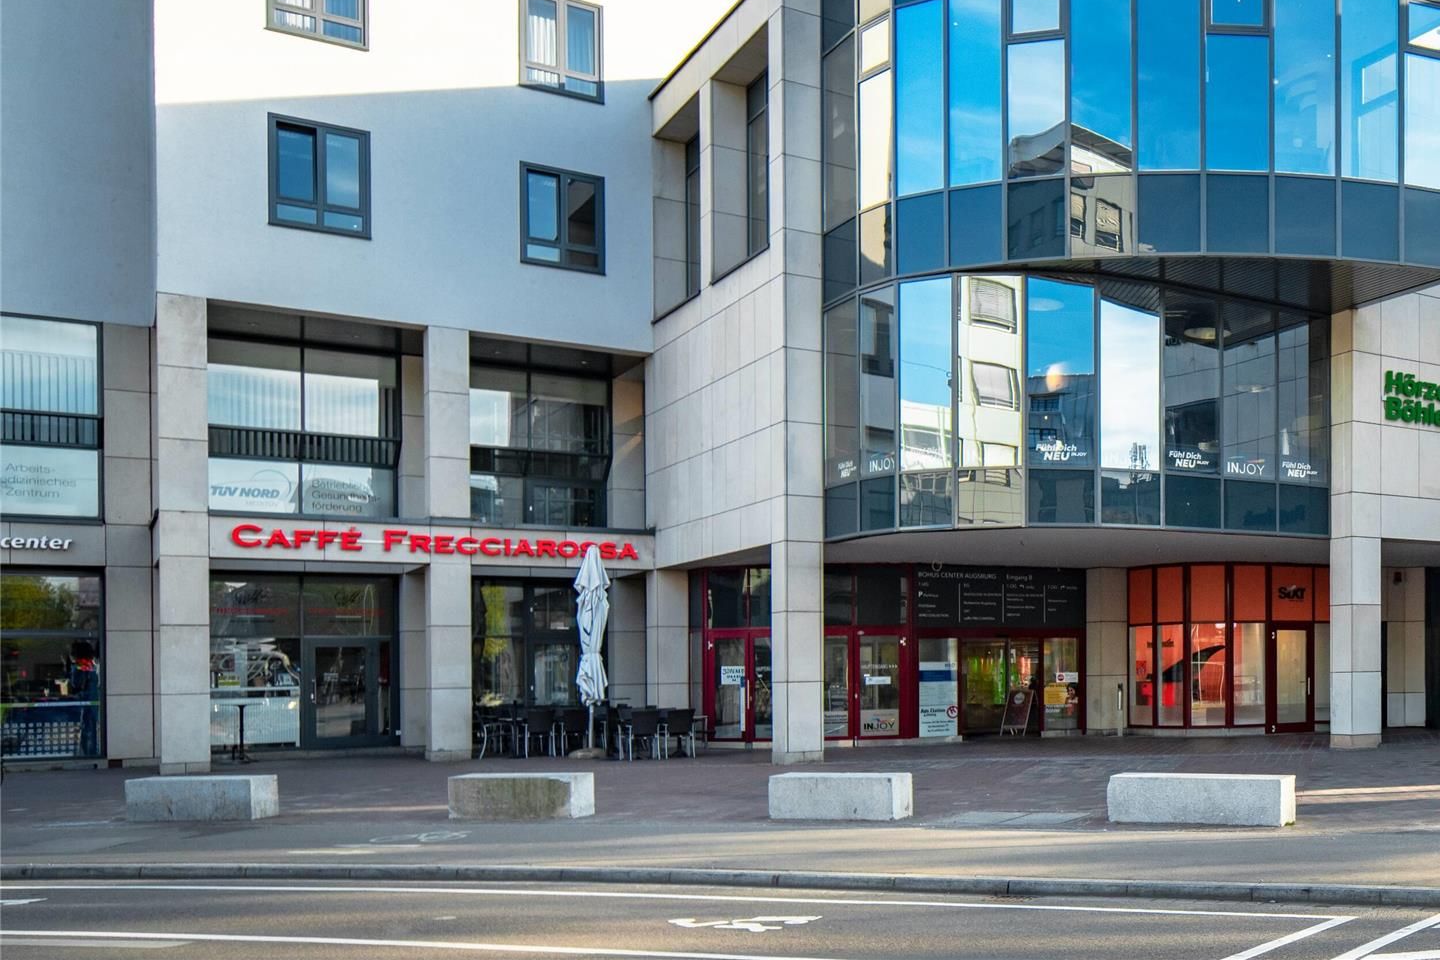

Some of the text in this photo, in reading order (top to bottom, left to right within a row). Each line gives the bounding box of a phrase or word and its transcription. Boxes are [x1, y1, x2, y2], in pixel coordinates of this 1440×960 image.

[1043, 451, 1071, 461] NEU
[1175, 458, 1196, 468] NEU
[1227, 461, 1265, 476] INJOY
[1287, 469, 1307, 478] NEU
[239, 488, 280, 499] NORD
[863, 722, 895, 730] INJOY
